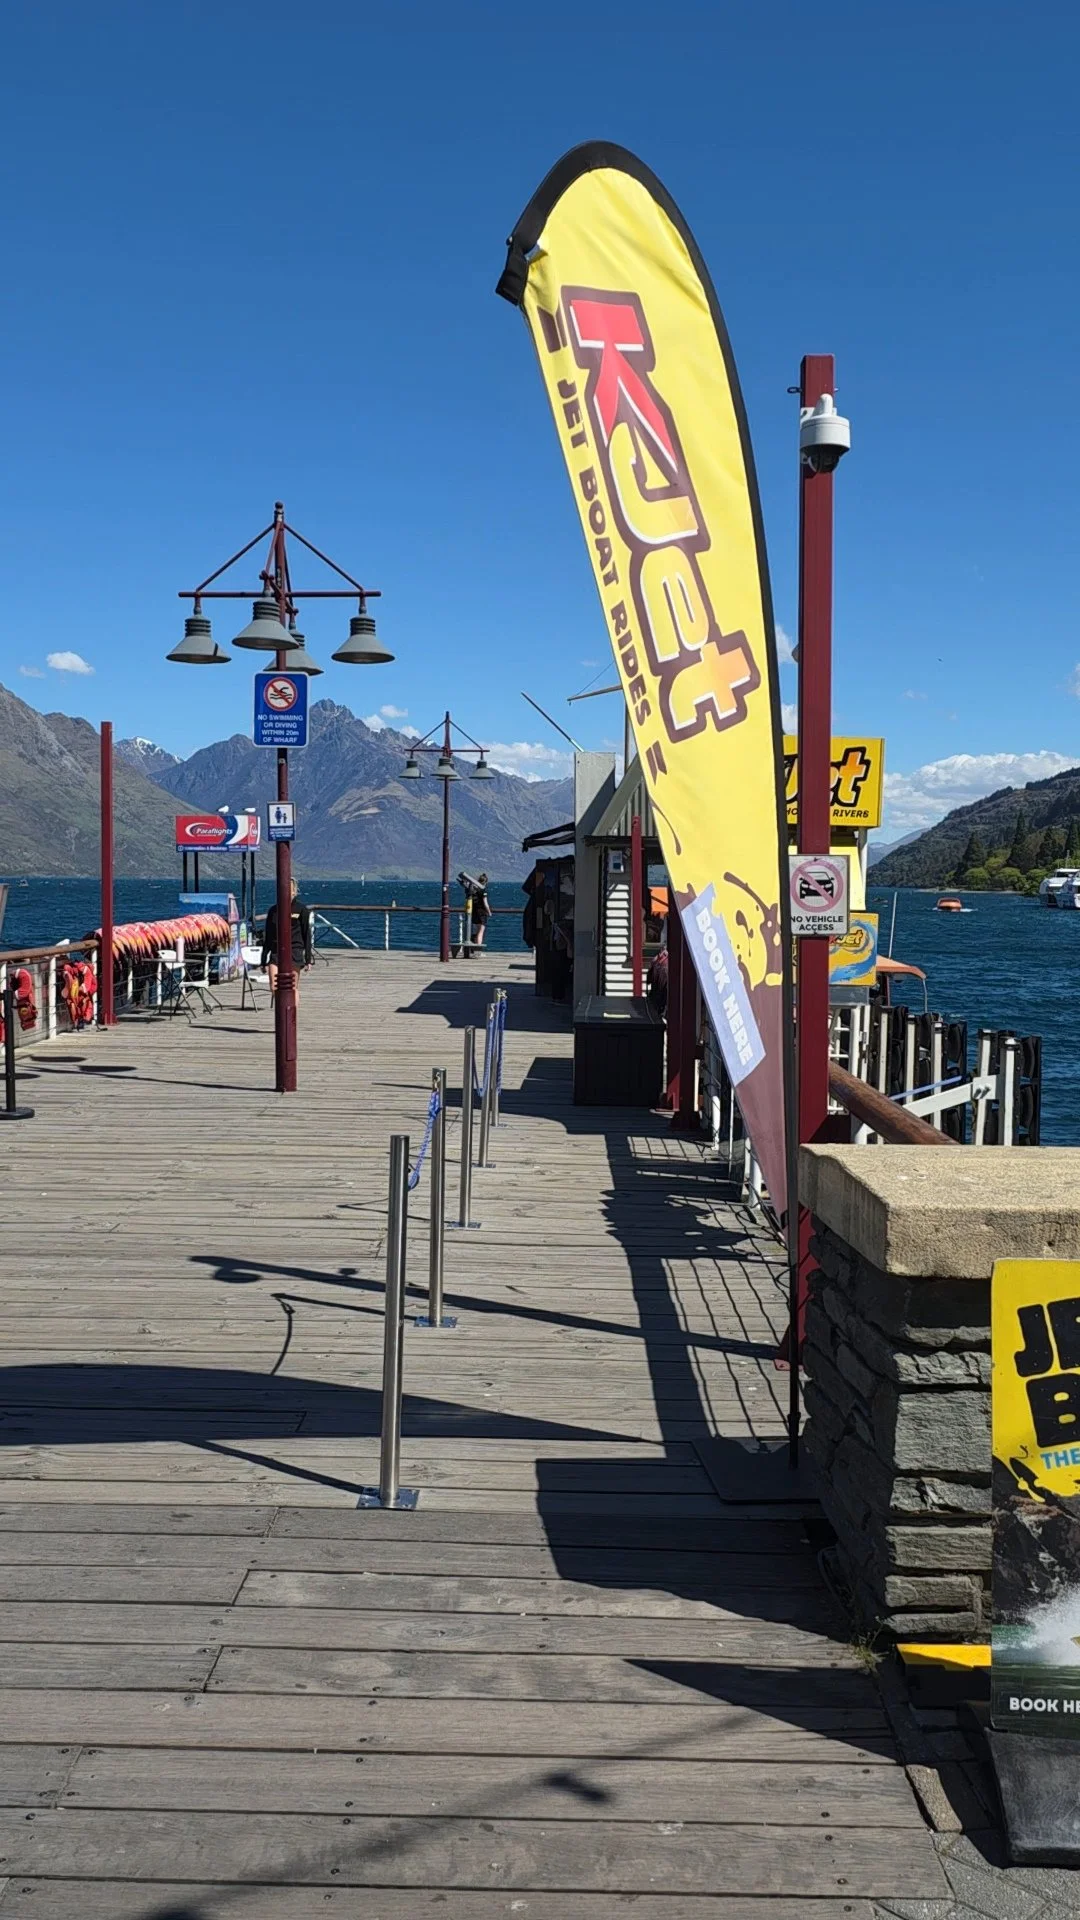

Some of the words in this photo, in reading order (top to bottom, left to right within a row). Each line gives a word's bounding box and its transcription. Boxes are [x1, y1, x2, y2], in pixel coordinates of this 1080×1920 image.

[561, 286, 761, 743] KJet
[557, 379, 588, 449] JET
[579, 465, 619, 587] BOAT
[611, 600, 652, 727] RIDES
[832, 809, 869, 818] RIVERS
[195, 827, 233, 836] Paraflights
[790, 915, 803, 923] NO
[805, 915, 844, 923] VEHICLE
[695, 907, 731, 994] BOOK
[723, 992, 754, 1067] HERE
[1009, 1696, 1059, 1712] BOOK
